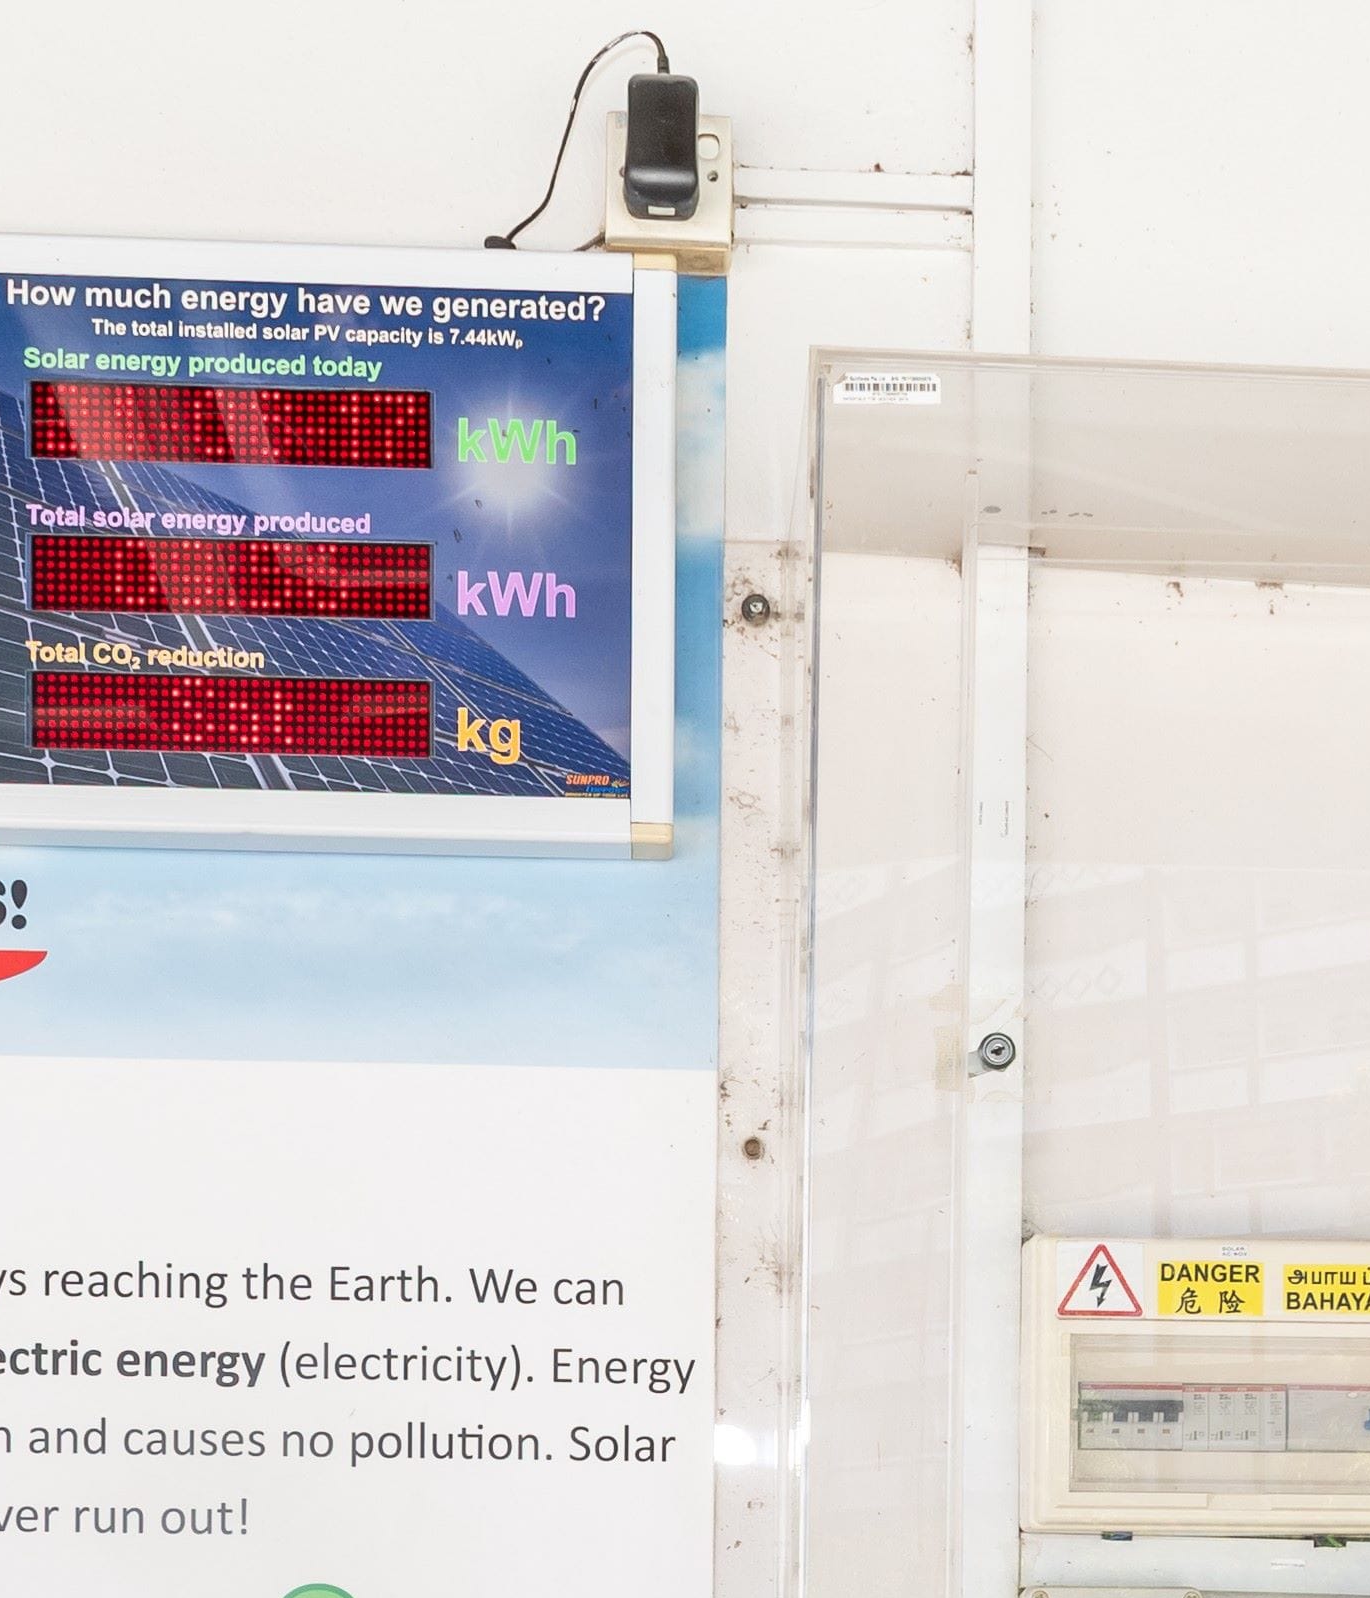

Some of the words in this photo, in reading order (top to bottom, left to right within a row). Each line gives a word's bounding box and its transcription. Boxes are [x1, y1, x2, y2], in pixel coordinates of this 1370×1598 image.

[8, 279, 75, 305] How
[86, 284, 170, 308] much
[182, 290, 287, 318] energy
[299, 288, 370, 314] have
[380, 296, 422, 315] we
[433, 296, 605, 323] generated?
[92, 319, 126, 335] The
[132, 321, 172, 336] total
[179, 321, 256, 339] installed
[263, 324, 309, 340] solar
[315, 325, 340, 341] PV
[345, 327, 422, 347] capacity
[429, 328, 444, 344] is
[24, 347, 89, 369] Solar
[96, 354, 181, 376] energy
[189, 353, 305, 377] produced
[313, 356, 382, 382] today
[457, 417, 577, 465] kWh
[26, 504, 85, 526] Total
[93, 507, 151, 529] solar
[161, 513, 246, 536] energy
[253, 512, 371, 536] produced
[457, 571, 576, 618] kWh
[26, 641, 86, 663] Total
[147, 647, 264, 670] reduction
[457, 708, 521, 763] kg
[566, 775, 610, 785] SUNPRO
[45, 1261, 227, 1308] reaching
[242, 1263, 311, 1300] the
[331, 1265, 451, 1302] Earth.
[469, 1269, 537, 1304] We
[554, 1279, 623, 1305] can
[1160, 1263, 1260, 1283] DANGER
